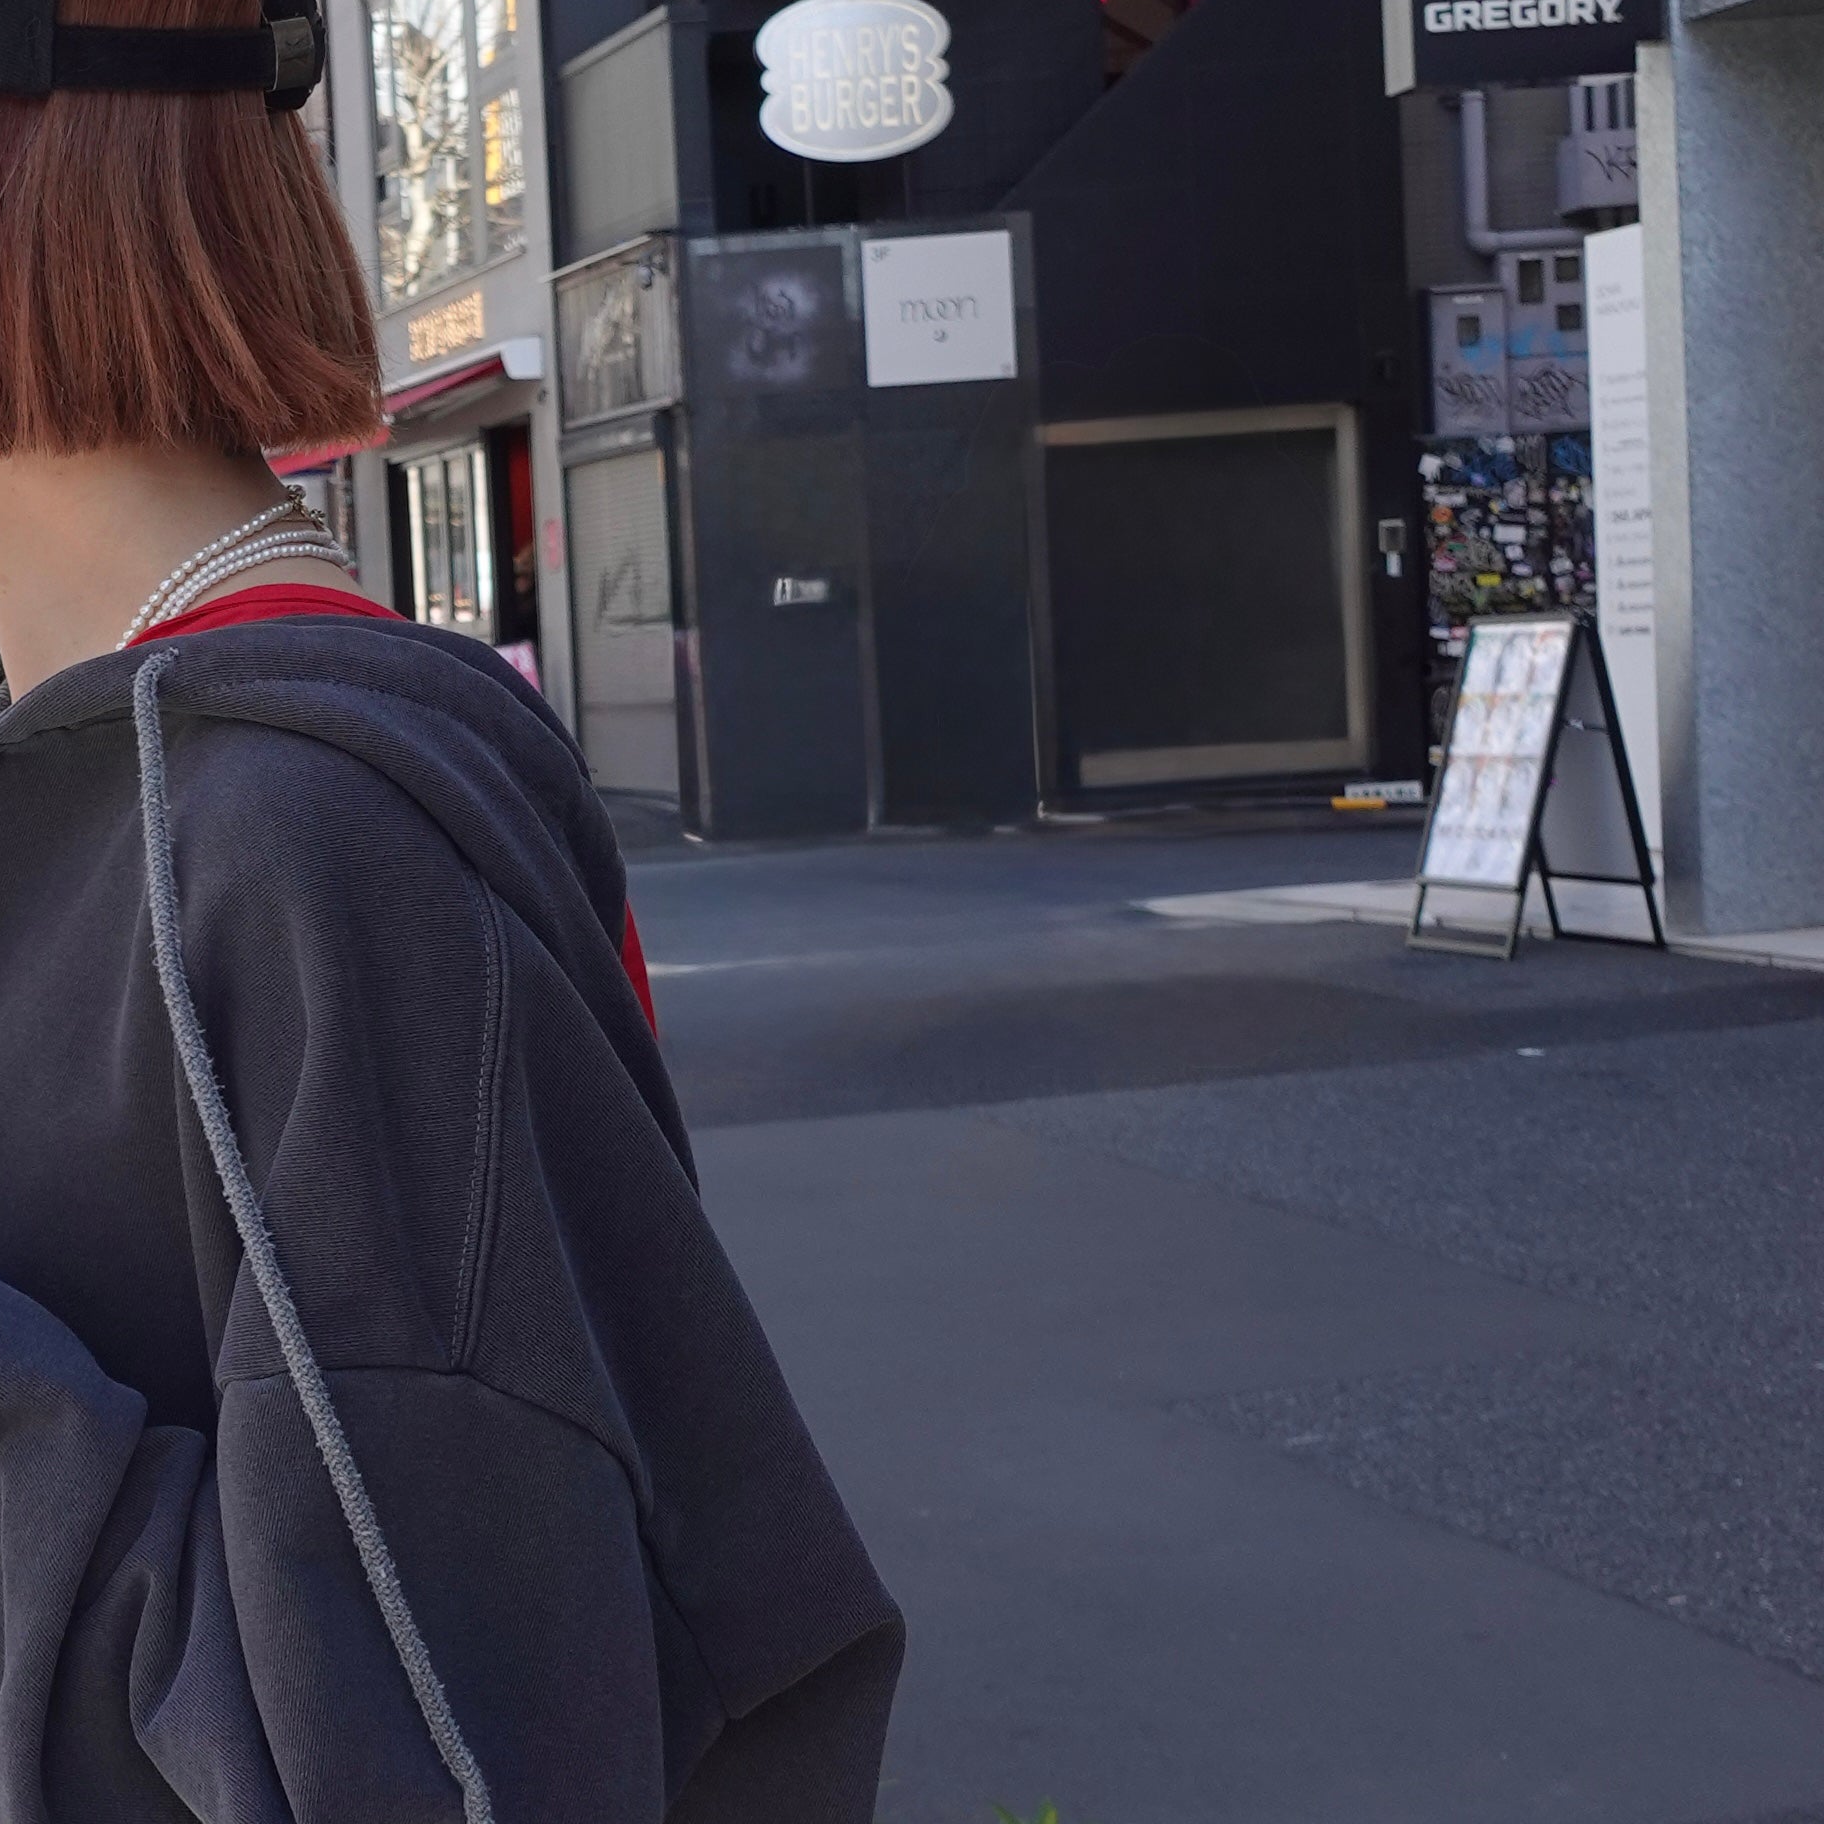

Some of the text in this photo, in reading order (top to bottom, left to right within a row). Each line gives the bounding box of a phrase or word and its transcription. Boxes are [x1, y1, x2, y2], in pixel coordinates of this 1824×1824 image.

[789, 24, 921, 79] HENRY'S
[791, 74, 923, 133] BURGER
[899, 295, 980, 322] moon
